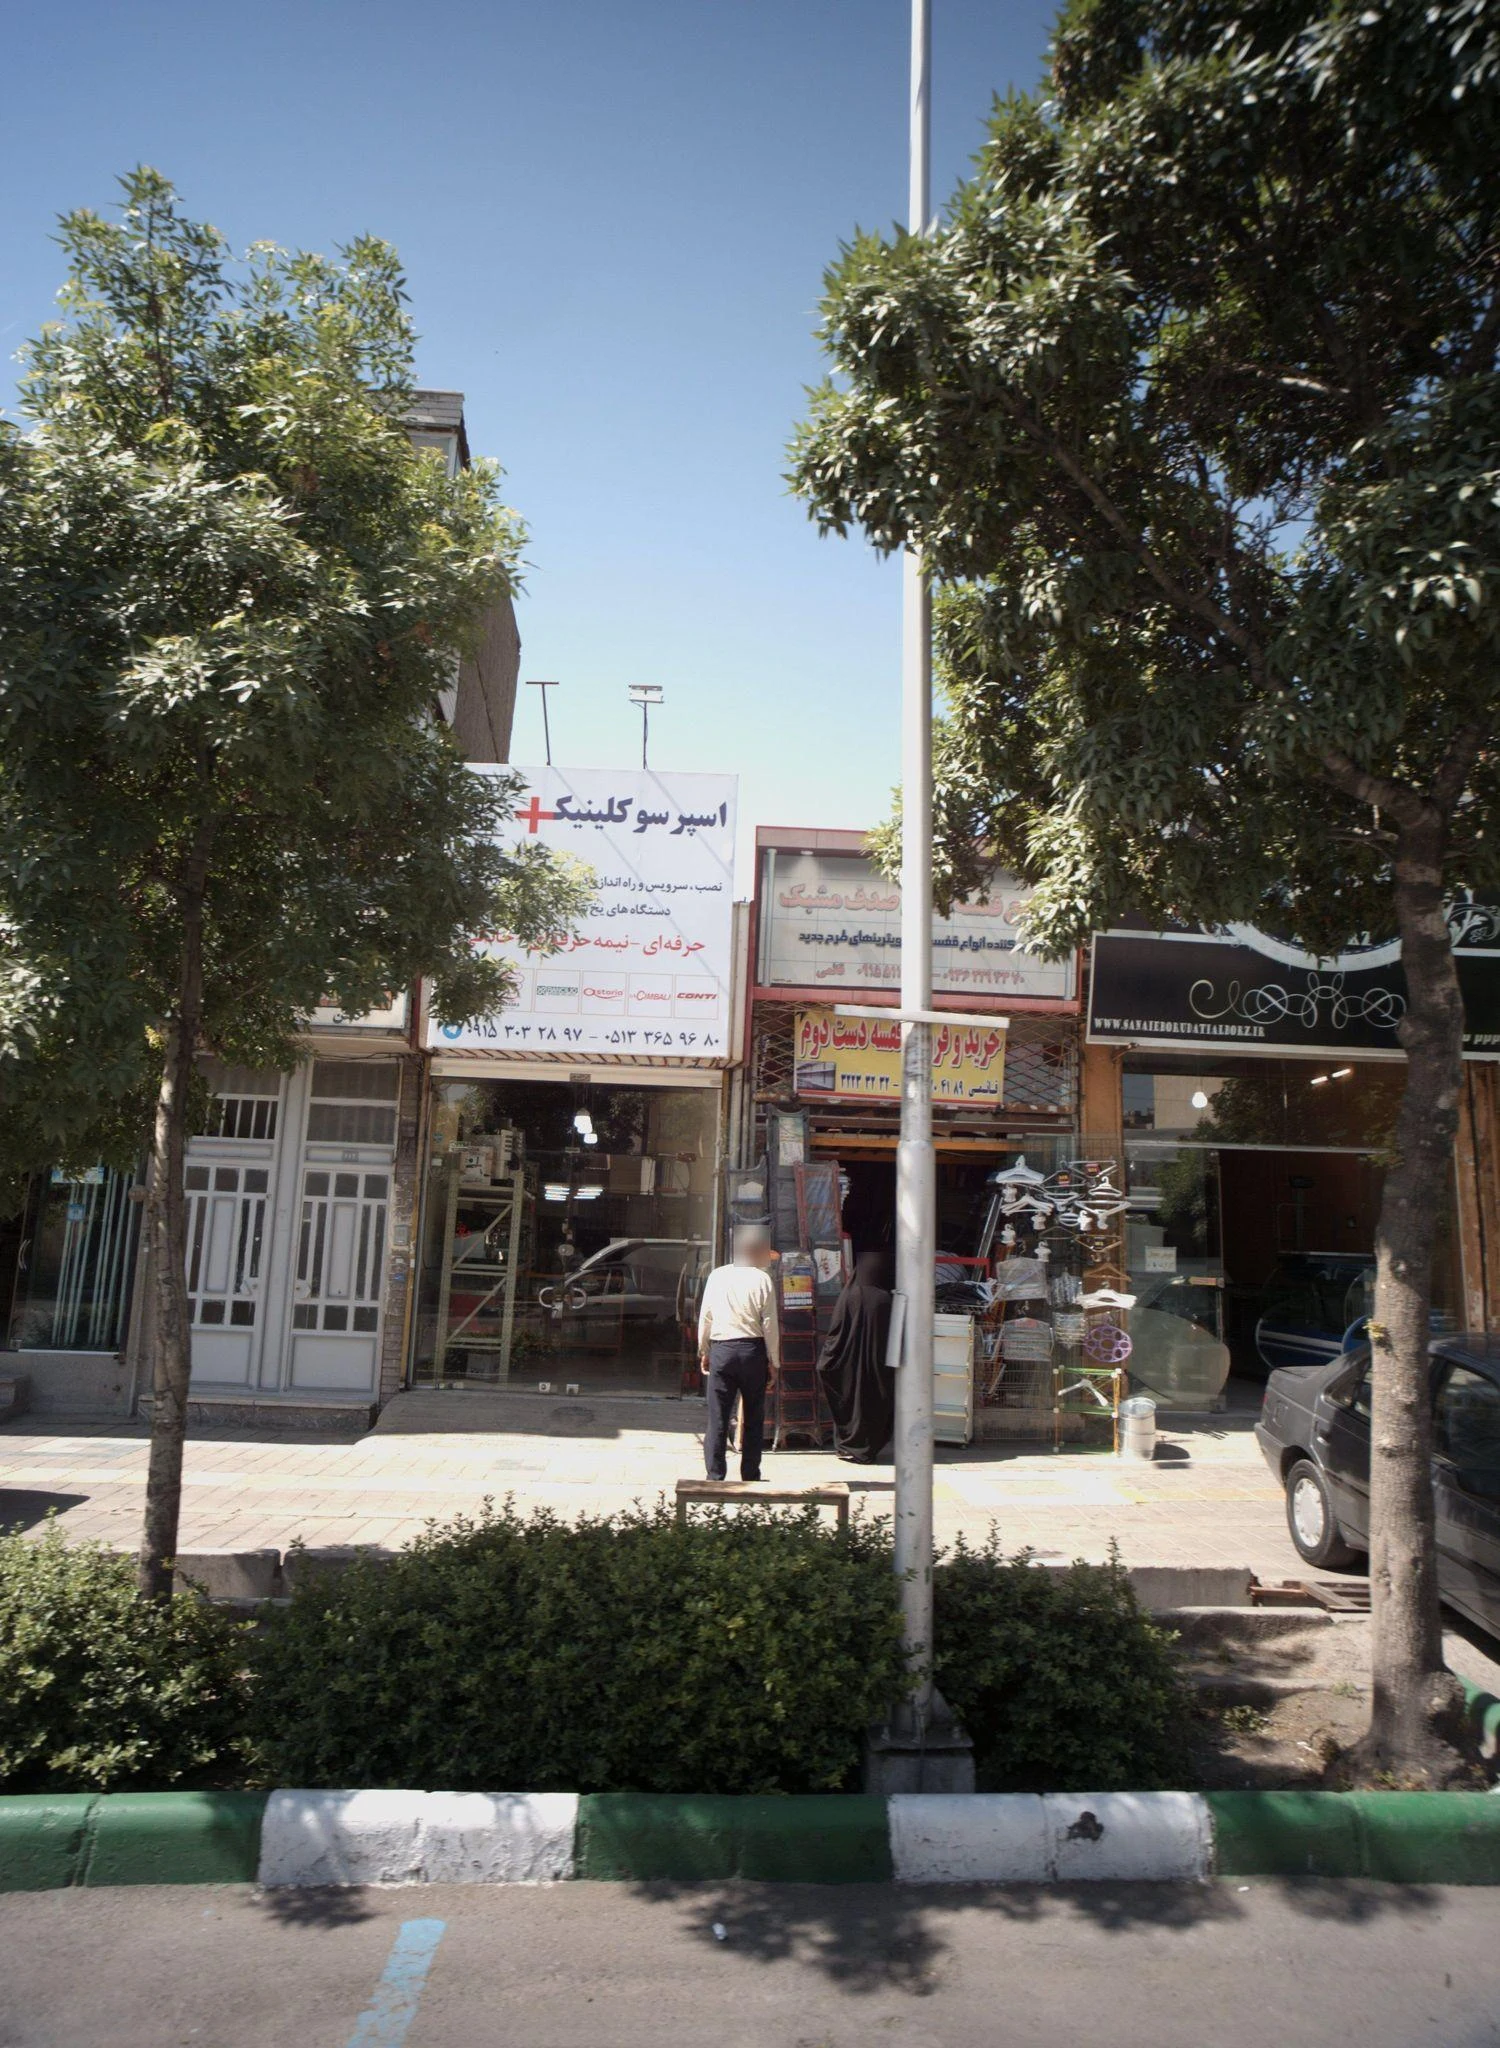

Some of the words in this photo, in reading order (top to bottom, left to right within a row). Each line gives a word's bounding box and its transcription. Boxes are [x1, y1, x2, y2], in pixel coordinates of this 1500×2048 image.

[554, 795, 634, 831] کلینیک
[638, 882, 644, 893] و
[645, 881, 688, 893] سرویس
[631, 904, 671, 916] دستگاه
[798, 931, 824, 945] جدید
[931, 934, 959, 948] قفس
[960, 935, 986, 951] انواع
[676, 992, 718, 1000] CONTI
[504, 1025, 531, 1039] ۳۰۳
[538, 1026, 557, 1040] ۲۸
[563, 1027, 583, 1041] ۹۷
[604, 1028, 637, 1043] ۰۵۱۳
[643, 1030, 673, 1045] ۳۶۵
[679, 1032, 697, 1045] ۹۶
[703, 1033, 719, 1046] ۸۰
[800, 1018, 829, 1059] دوم
[832, 1019, 869, 1050] دست
[951, 1033, 961, 1068] و
